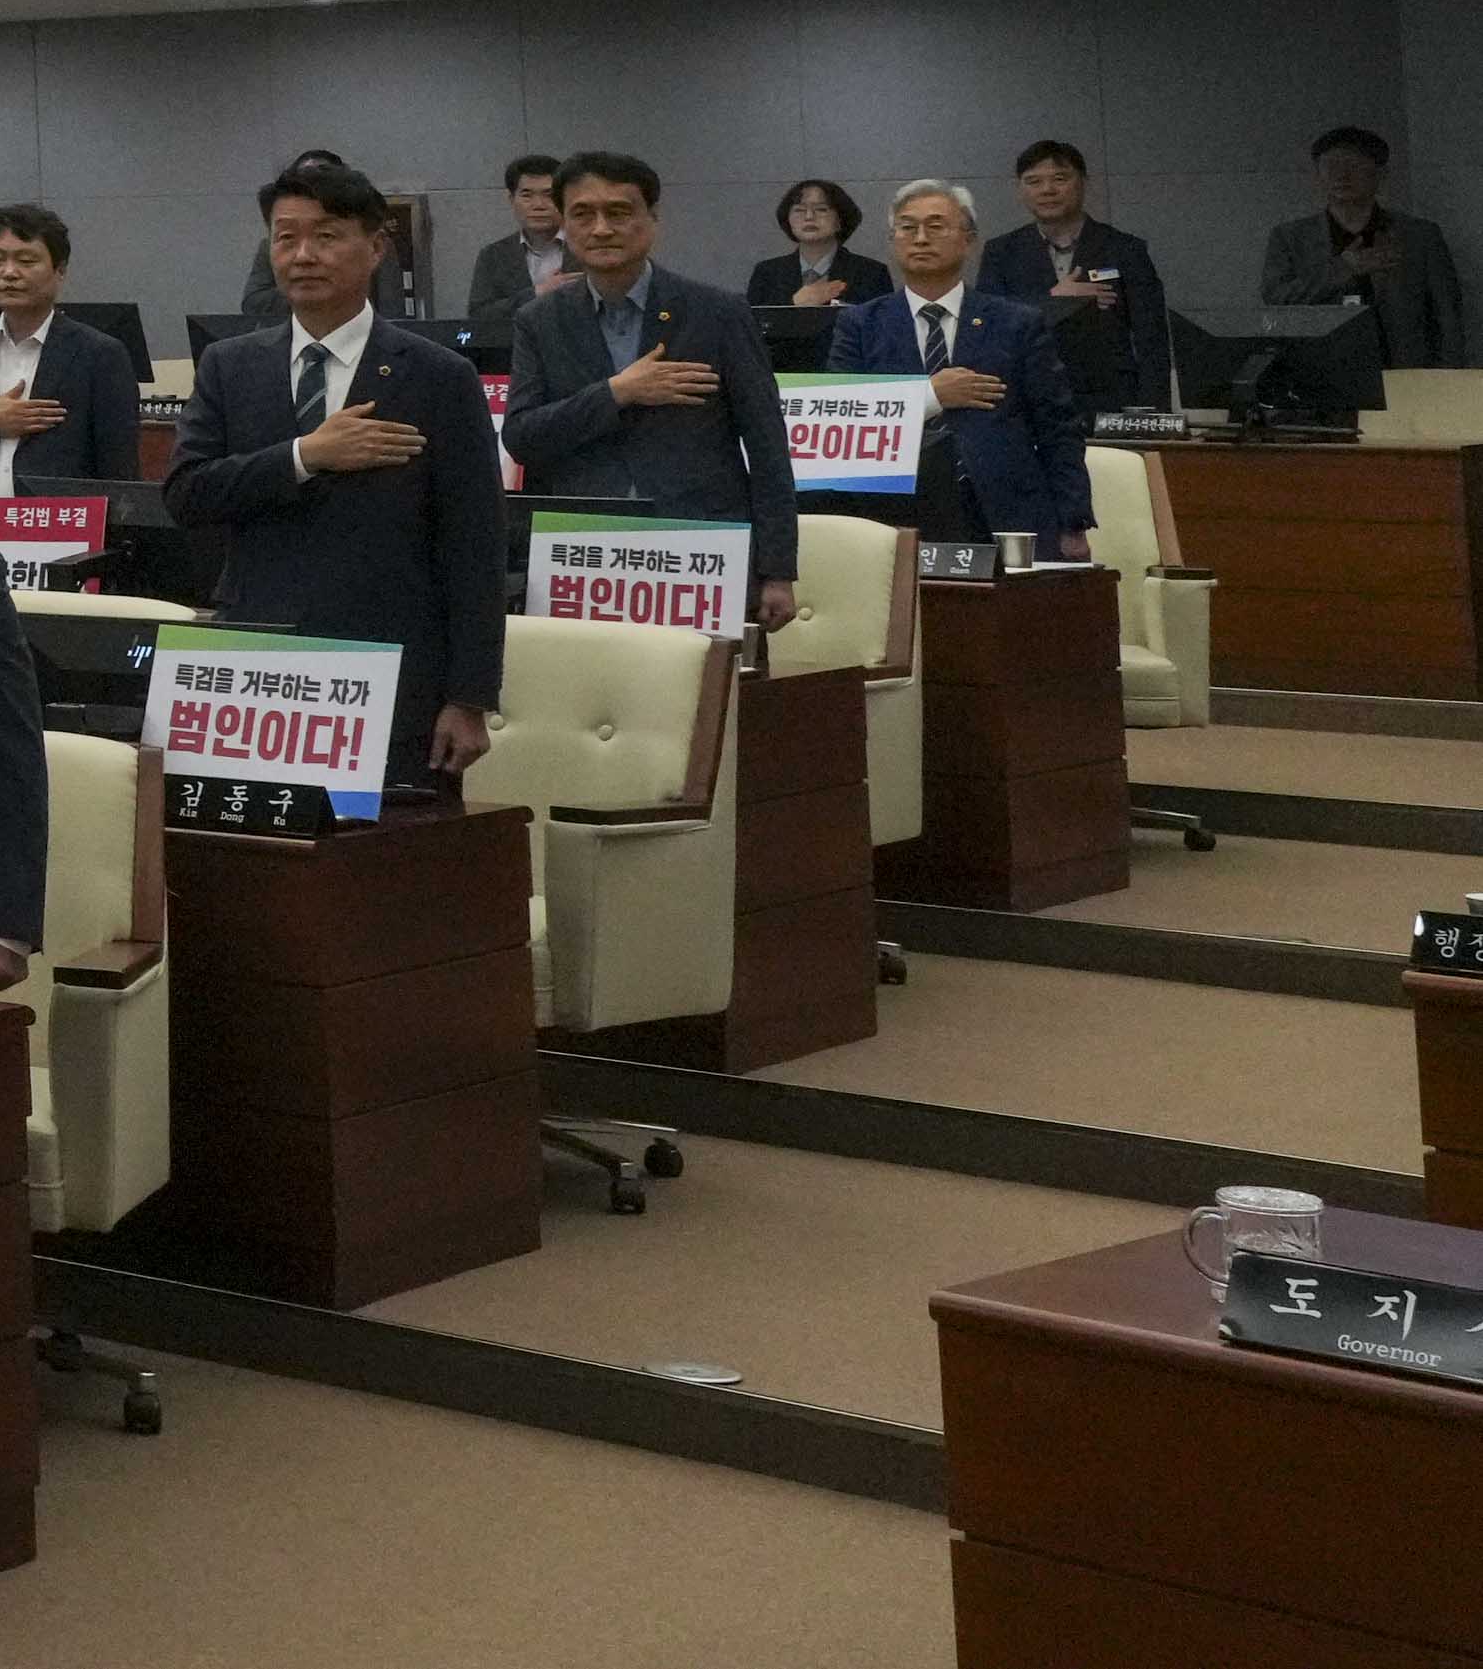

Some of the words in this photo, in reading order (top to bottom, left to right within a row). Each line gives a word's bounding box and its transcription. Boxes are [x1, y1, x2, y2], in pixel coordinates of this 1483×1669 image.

[808, 399, 869, 418] 거부하는
[874, 400, 905, 418] 자가
[789, 423, 902, 462] 인이다!
[4, 507, 51, 527] 특검법
[56, 507, 88, 527] 부결
[551, 543, 603, 569] 특검을
[609, 548, 682, 574] 거부하는
[688, 553, 725, 576] 자가
[550, 574, 724, 631] 범인이다!
[175, 663, 235, 694] 특검을
[240, 670, 321, 703] 거부하는
[328, 678, 371, 707] 자가
[167, 699, 365, 772] 범인이다!
[1337, 1332, 1444, 1369] Governor
